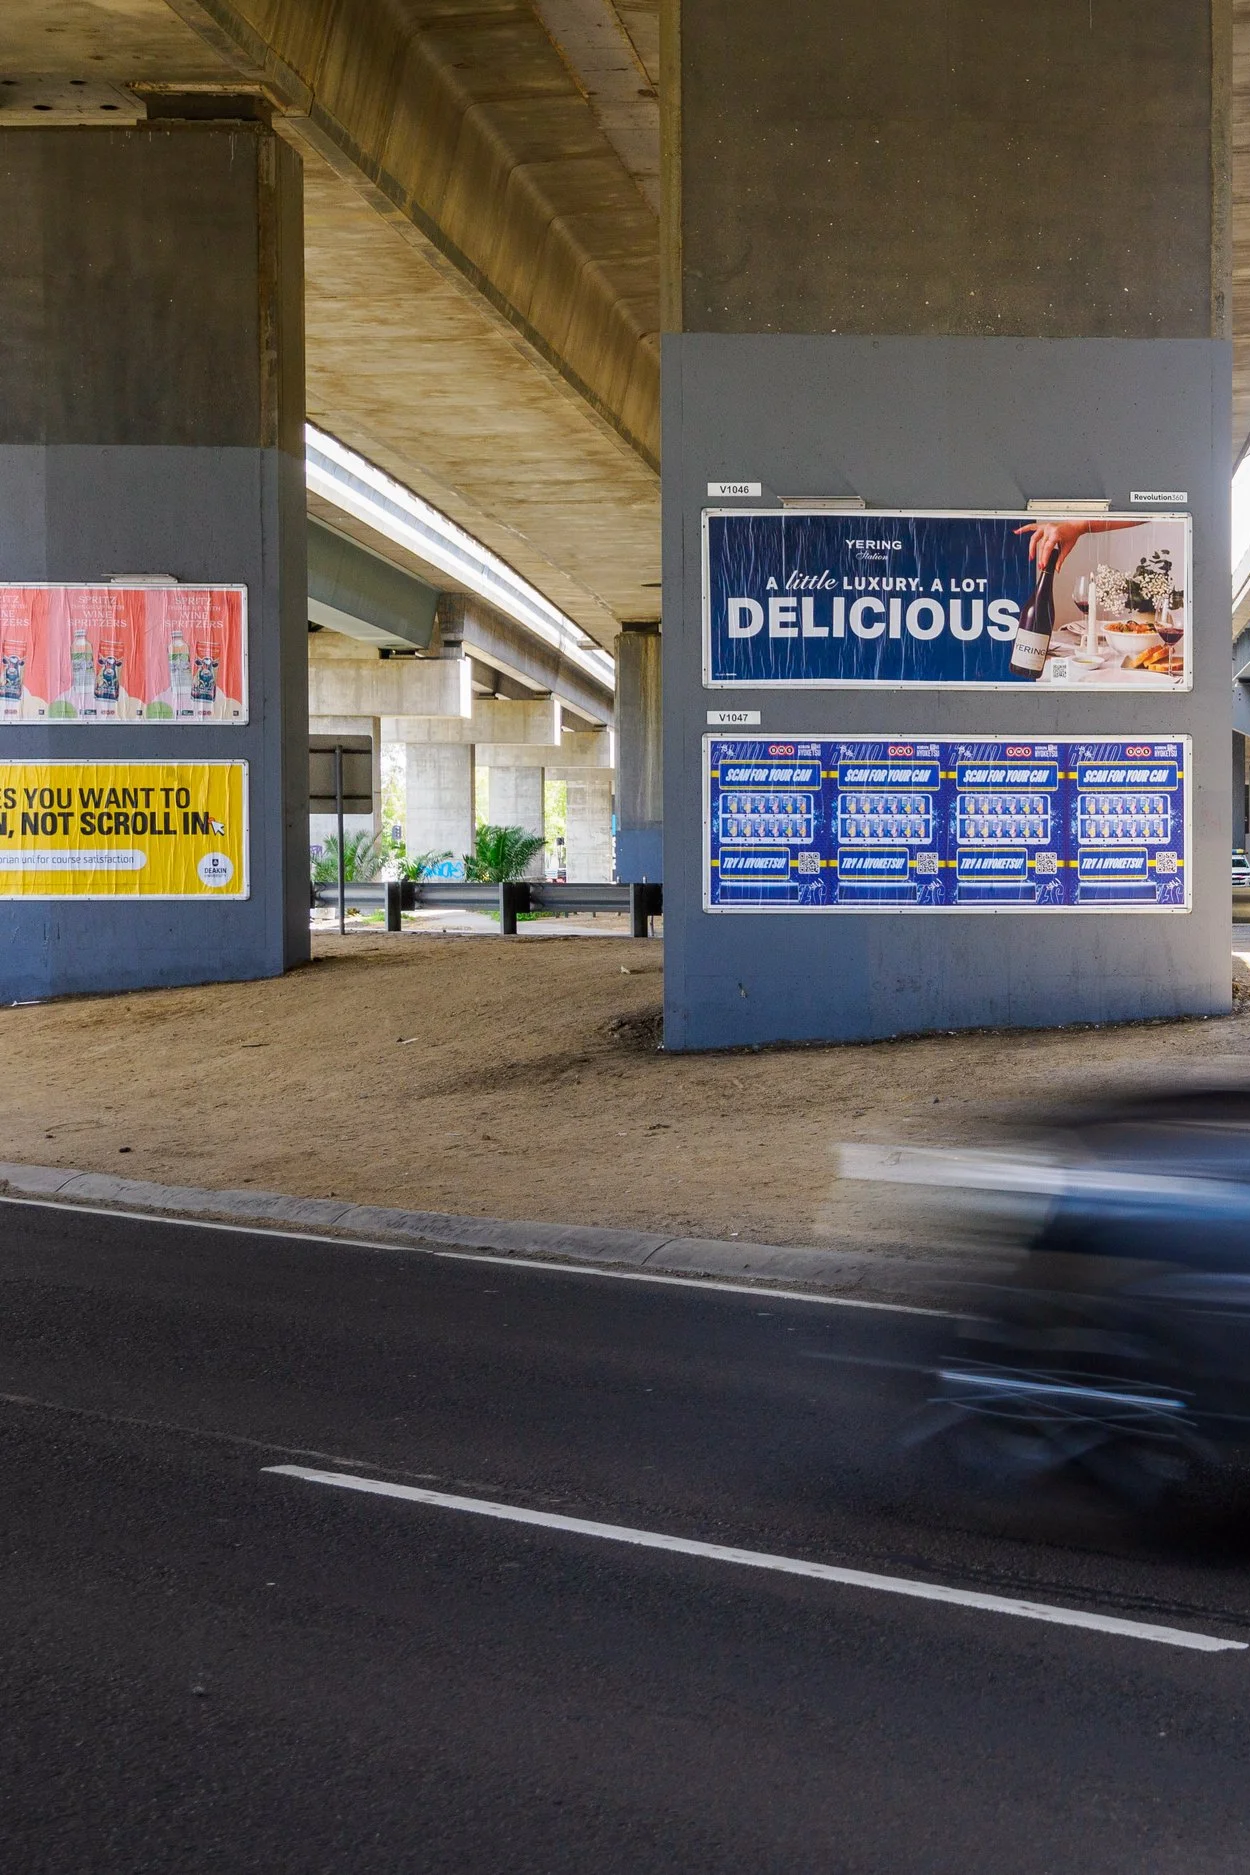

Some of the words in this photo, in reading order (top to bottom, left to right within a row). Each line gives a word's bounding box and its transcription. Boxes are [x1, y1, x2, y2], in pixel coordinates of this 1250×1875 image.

[719, 485, 749, 494] V1046
[1134, 493, 1184, 501] Revolution360
[845, 539, 902, 550] YERING
[855, 550, 888, 560] Station
[766, 576, 779, 590] A
[785, 570, 839, 590] little
[843, 577, 923, 591] LUXURY.
[931, 578, 943, 592] A
[951, 578, 988, 592] LOT
[78, 595, 118, 605] SPRITZ
[175, 596, 212, 606] SPRITZ
[83, 610, 113, 619] WINE
[181, 611, 209, 620] WINE
[728, 596, 1020, 641] DELICIOUS
[164, 620, 224, 629] SPRITZERS
[719, 713, 748, 722] V1047
[726, 769, 753, 781] SCAN
[750, 769, 769, 781] FOR
[769, 769, 793, 781] YOUR
[792, 769, 812, 781] CAN
[845, 769, 870, 782] SCAN
[868, 769, 887, 782] FOR
[887, 769, 912, 782] YOUR
[911, 769, 931, 782] CAN
[963, 769, 988, 783] SCAN
[987, 769, 1006, 783] FOR
[1006, 769, 1031, 783] YOUR
[1030, 769, 1050, 783] CAN
[1083, 769, 1109, 783] SCAN
[1107, 769, 1126, 783] FOR
[1126, 769, 1151, 783] YOUR
[1149, 769, 1169, 783] CAN
[24, 788, 72, 809] YOU
[79, 788, 155, 809] WANT
[160, 788, 191, 809] TO
[21, 812, 75, 836] NOT
[80, 812, 177, 836] SCROLL
[183, 811, 210, 836] IN
[22, 855, 35, 864] uni
[36, 854, 50, 864] for
[52, 856, 81, 864] course
[83, 854, 134, 864] satisfaction
[723, 857, 739, 869] TRY
[737, 857, 745, 869] A
[841, 857, 858, 869] TRY
[856, 857, 864, 869] A
[960, 857, 977, 869] TRY
[975, 857, 982, 869] A
[1082, 857, 1099, 869] TRY
[1095, 857, 1103, 869] A
